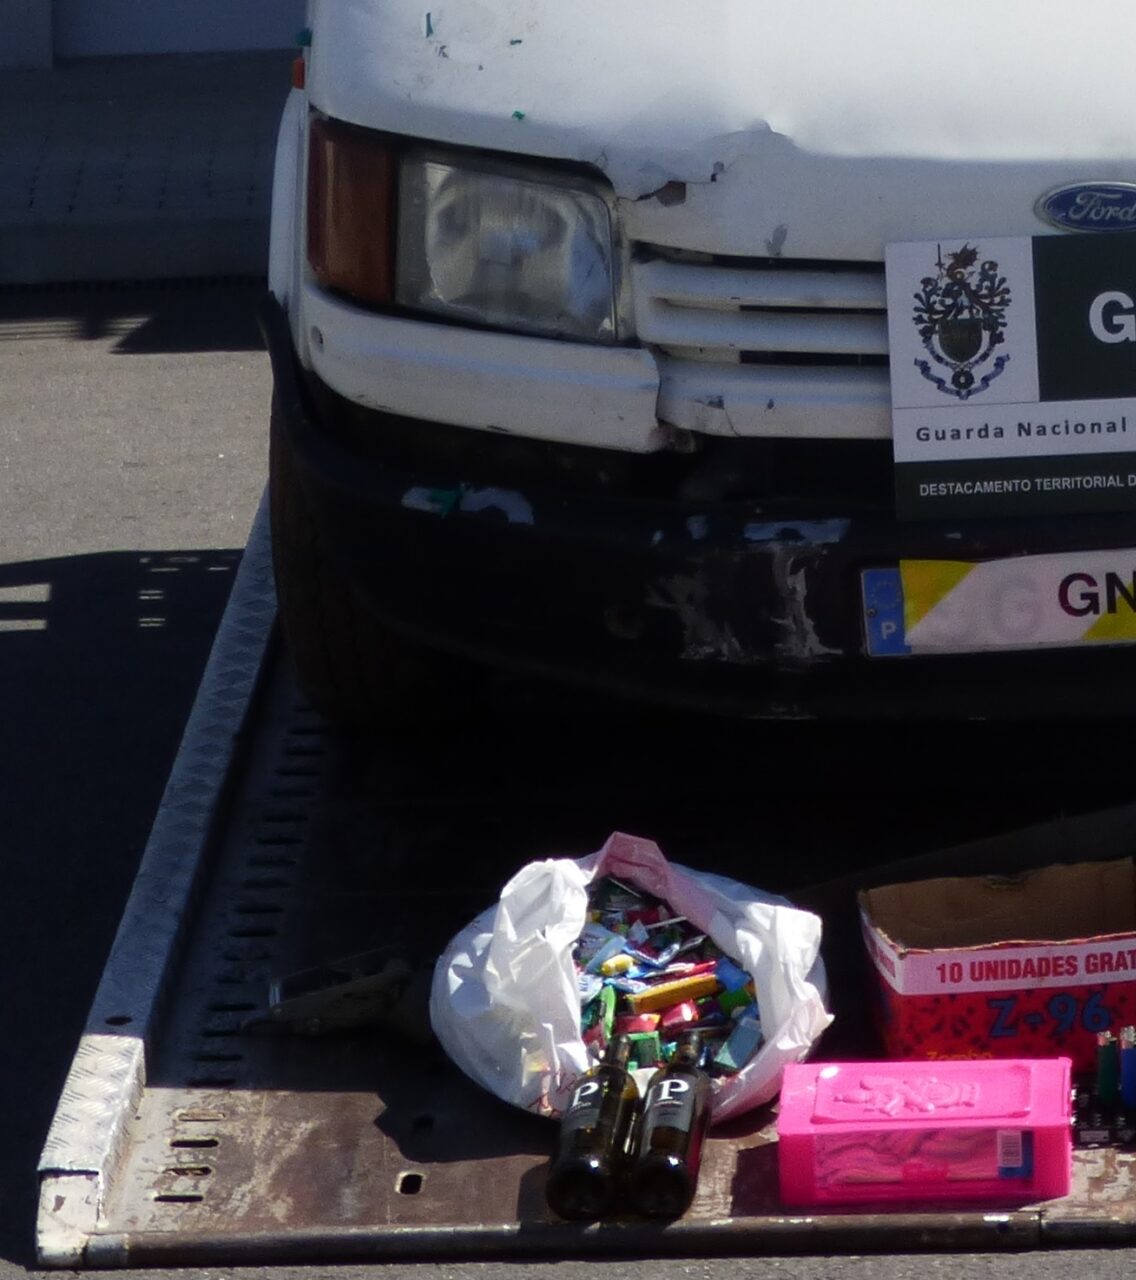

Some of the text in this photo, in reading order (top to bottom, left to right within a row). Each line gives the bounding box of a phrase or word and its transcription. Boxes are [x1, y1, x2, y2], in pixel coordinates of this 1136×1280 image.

[916, 423, 1005, 442] Guarda
[1017, 417, 1127, 437] Nacional
[919, 479, 1032, 497] DESTACAMENTO
[1034, 473, 1125, 491] TERRITORIAL
[881, 622, 896, 639] P
[936, 962, 963, 984] 10
[969, 955, 1079, 982] UNIDADES
[987, 992, 1111, 1038] Z-96
[572, 1081, 599, 1108] P
[657, 1079, 689, 1101] P
